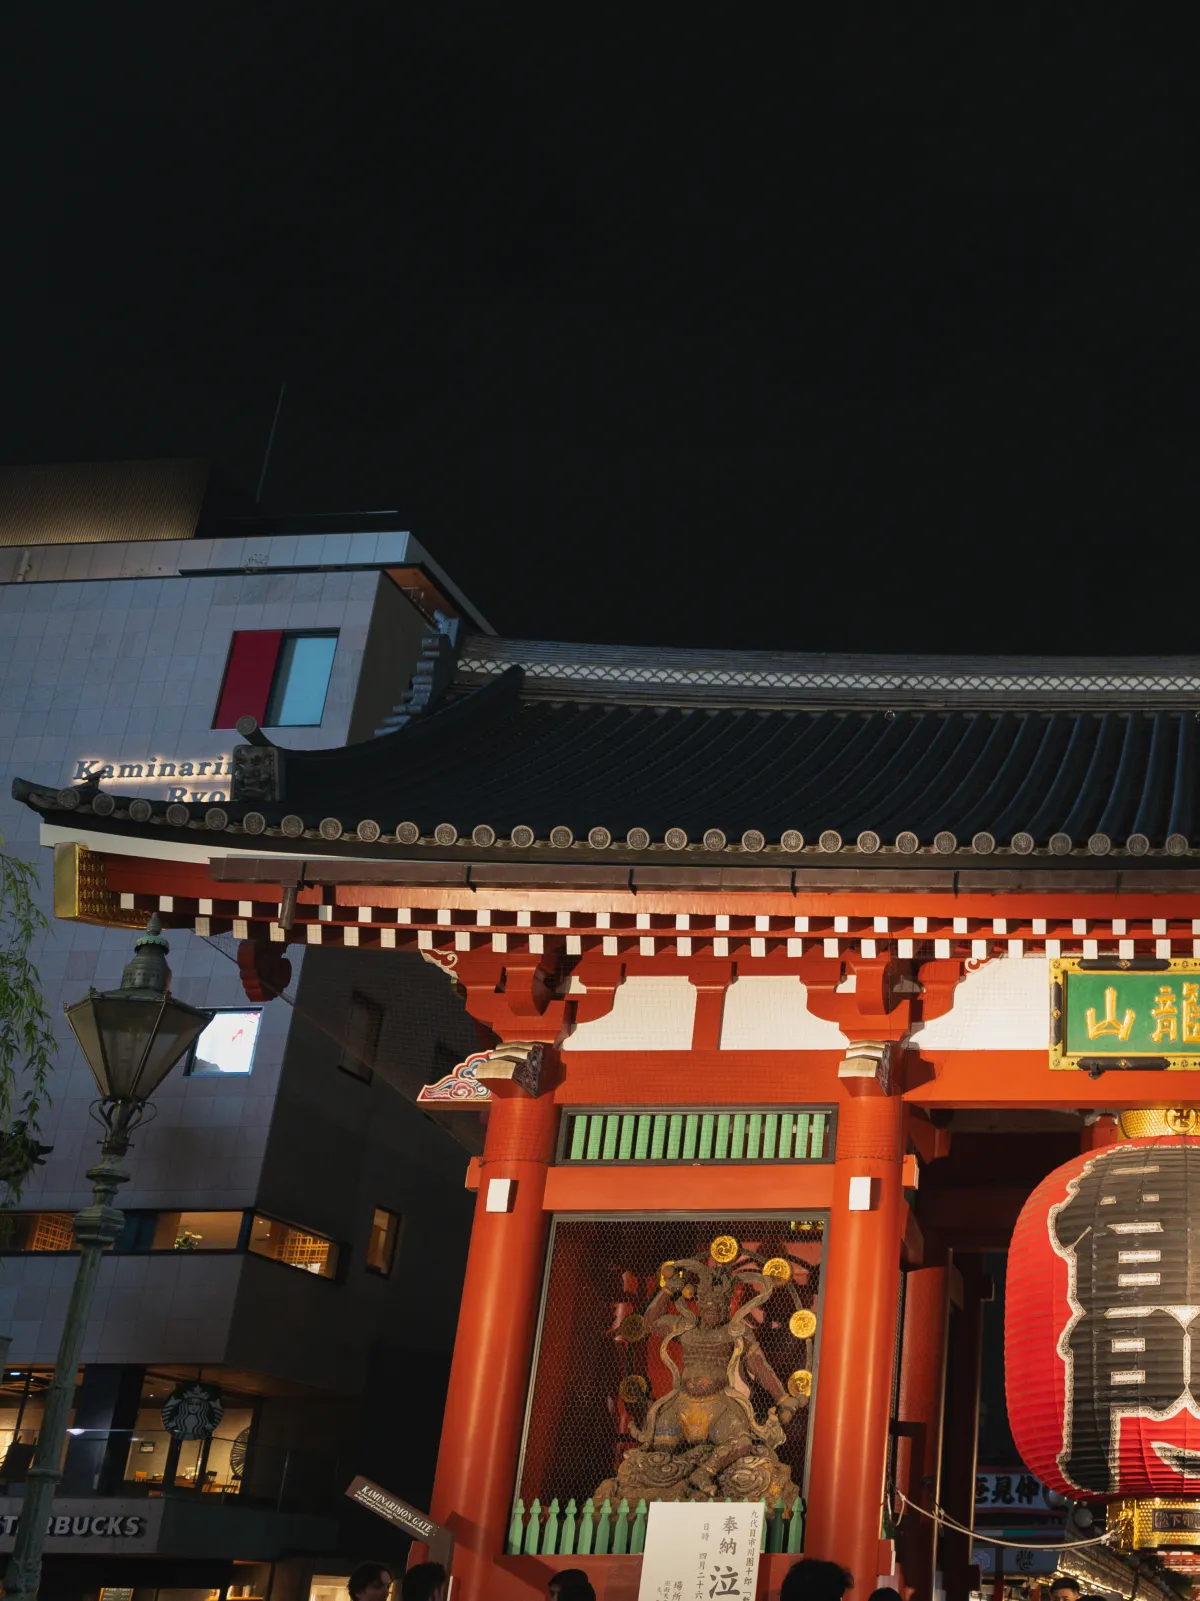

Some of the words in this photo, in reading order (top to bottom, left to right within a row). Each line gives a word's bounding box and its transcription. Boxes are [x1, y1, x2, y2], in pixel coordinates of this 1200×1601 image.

[0, 1515, 140, 1535] TBUCKS
[361, 1485, 413, 1521] KAMINARIMON
[412, 1517, 433, 1533] GATE
